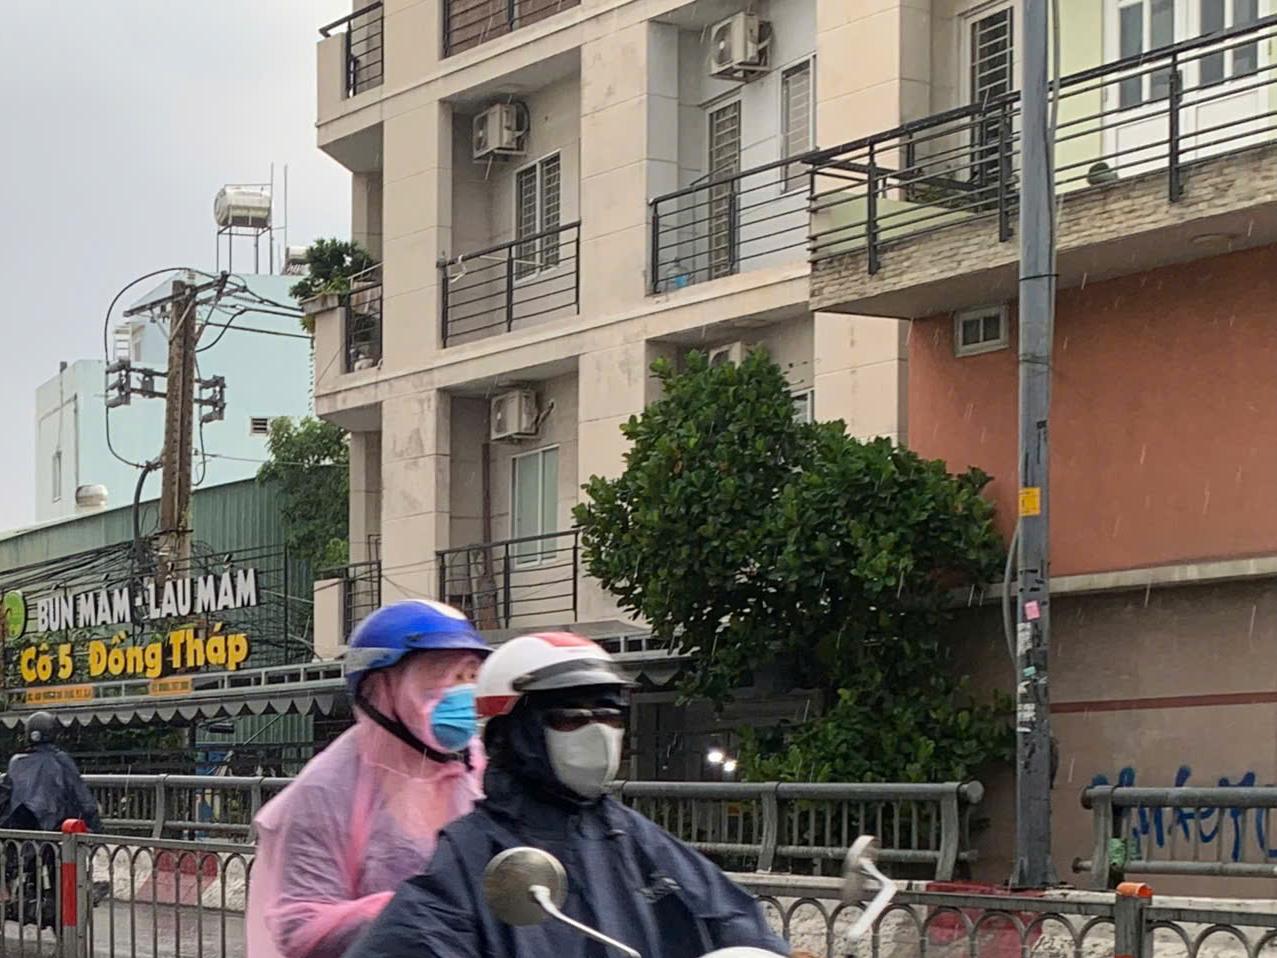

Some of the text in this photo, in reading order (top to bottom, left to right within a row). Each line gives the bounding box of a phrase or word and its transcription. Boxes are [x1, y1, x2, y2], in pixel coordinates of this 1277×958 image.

[20, 642, 53, 683] Cô
[57, 643, 73, 680] 5
[169, 622, 249, 671] Tháp
